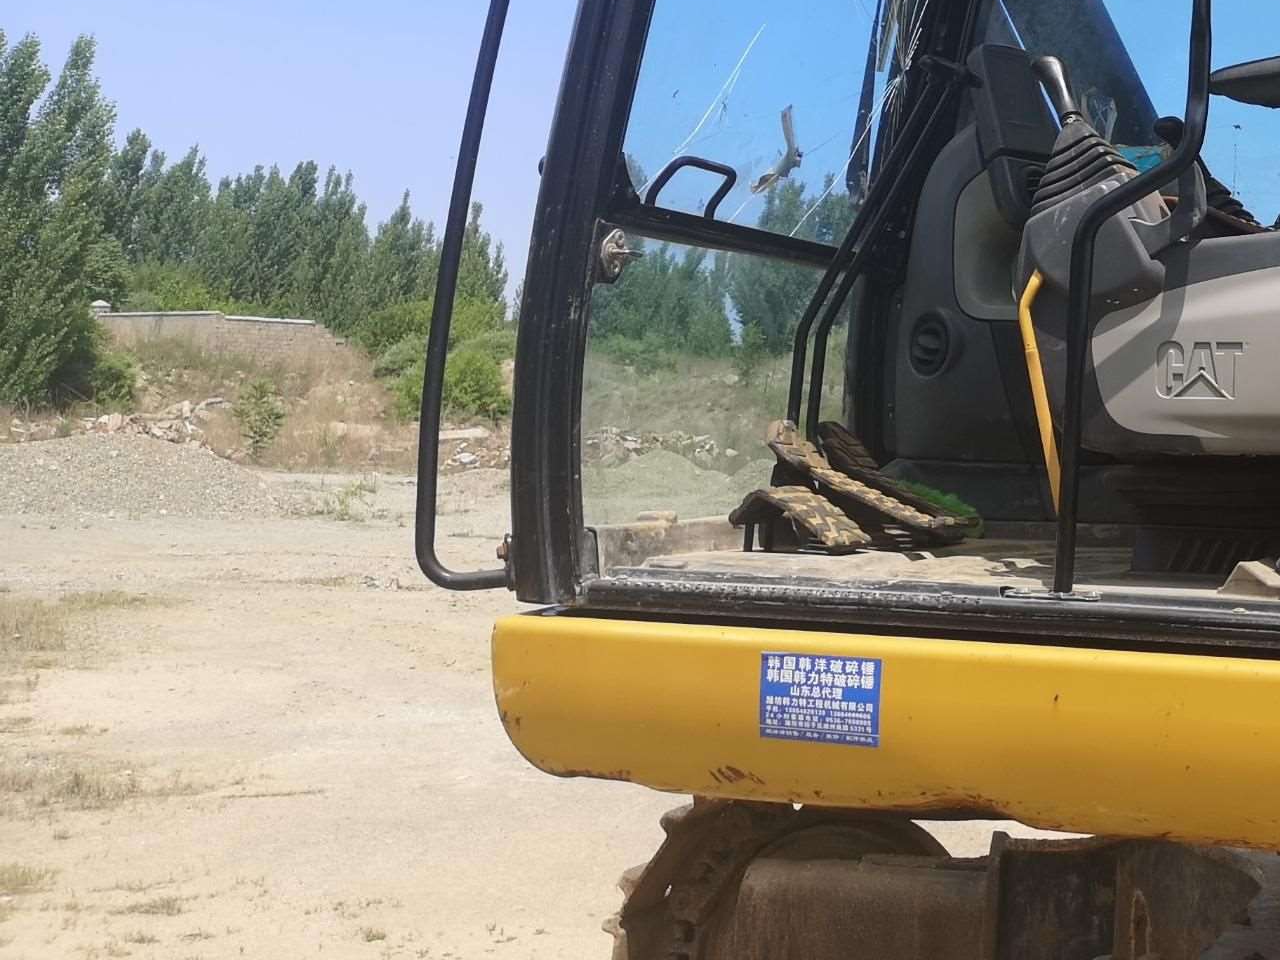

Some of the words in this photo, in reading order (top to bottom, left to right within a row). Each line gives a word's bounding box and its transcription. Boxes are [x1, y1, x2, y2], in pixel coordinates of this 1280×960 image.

[1155, 341, 1244, 400] CAT
[790, 685, 843, 700] 山东总代理
